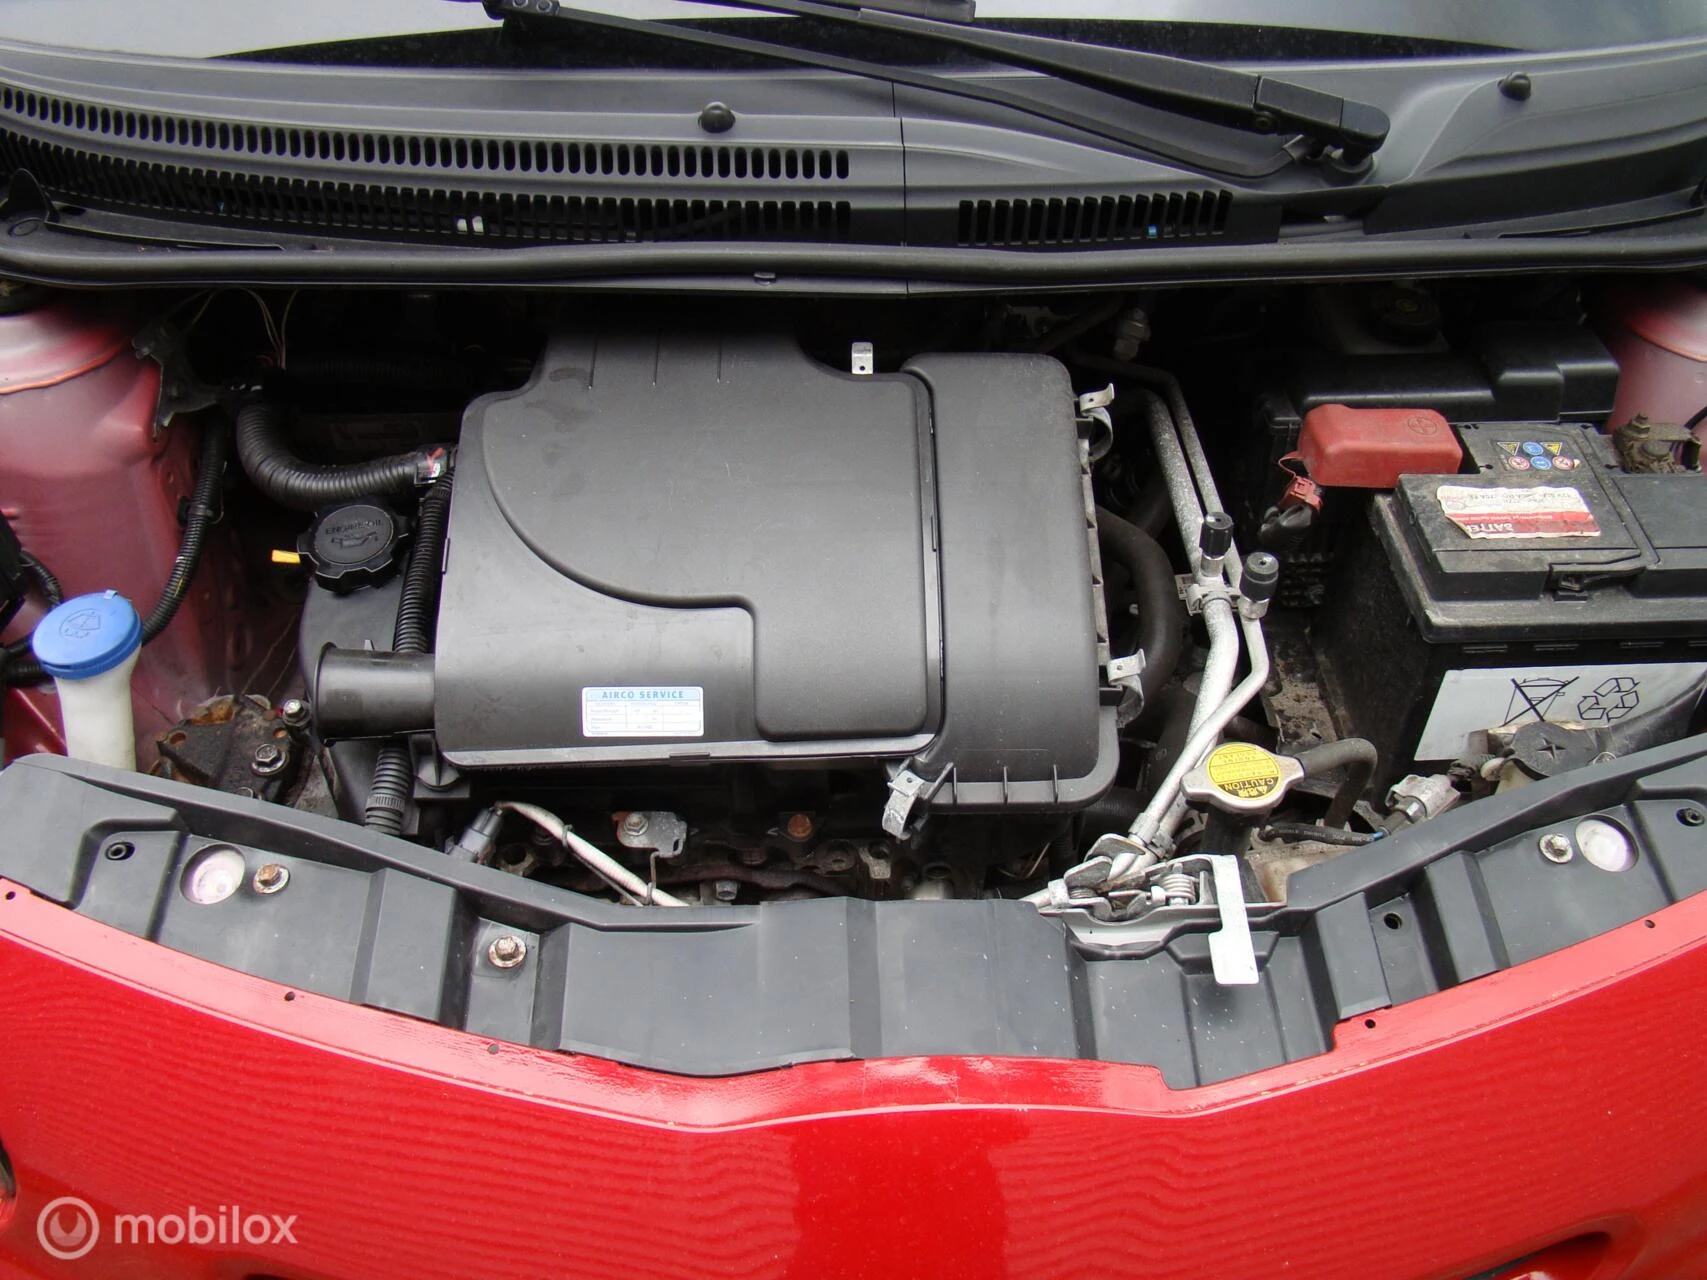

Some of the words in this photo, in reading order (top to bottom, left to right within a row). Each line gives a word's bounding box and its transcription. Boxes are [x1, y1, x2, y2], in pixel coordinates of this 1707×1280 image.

[602, 691, 635, 699] AIRCO
[639, 690, 684, 699] SERVICE
[1224, 777, 1274, 791] CAUTION
